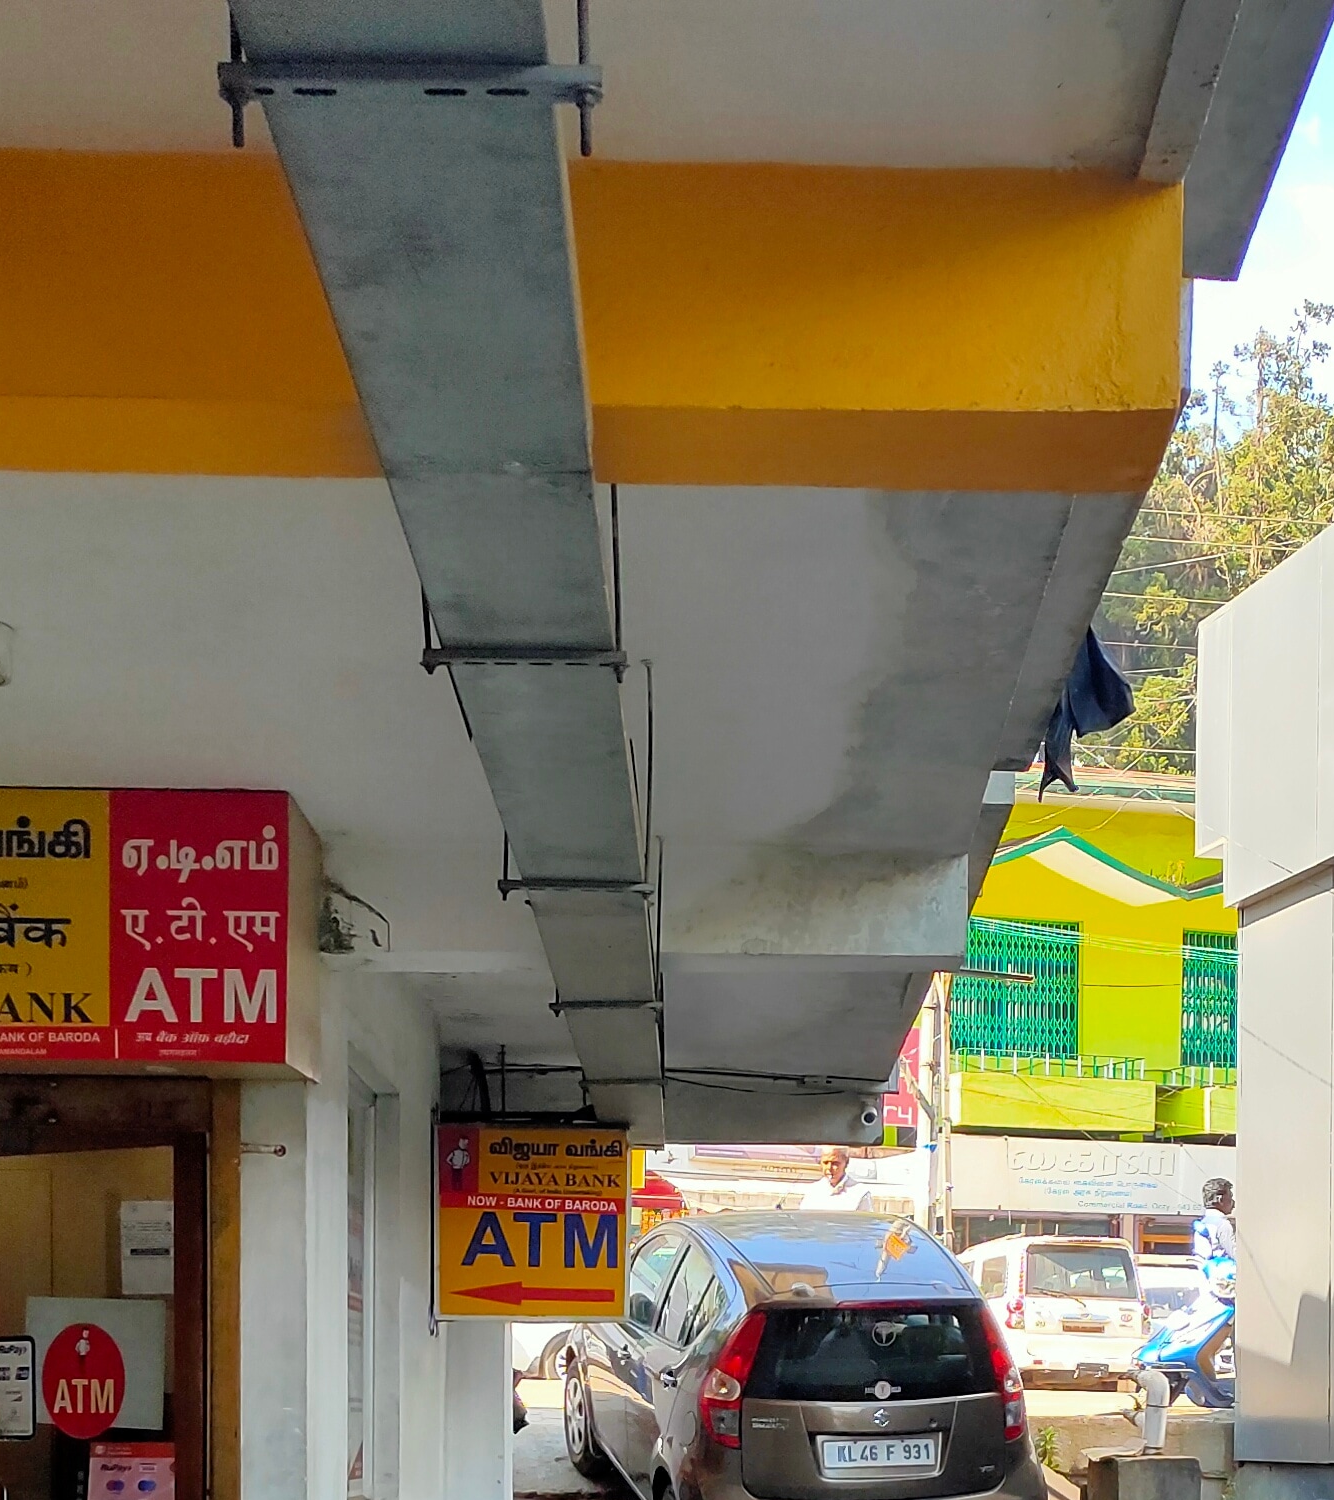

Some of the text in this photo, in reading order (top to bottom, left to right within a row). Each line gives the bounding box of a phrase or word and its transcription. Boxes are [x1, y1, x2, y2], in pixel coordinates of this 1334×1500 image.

[122, 825, 279, 883] ஏ.டி.எம்
[124, 967, 277, 1024] ATM
[28, 1032, 44, 1043] OF
[48, 1032, 100, 1043] BARODA
[489, 1136, 623, 1161] விஜயா வங்கி
[490, 1171, 621, 1188] VIJAYA BANK
[467, 1195, 497, 1207] NOW
[507, 1197, 542, 1209] BANK
[545, 1199, 561, 1209] OF
[565, 1200, 618, 1212] BARODA
[461, 1211, 619, 1269] ATM
[53, 1378, 115, 1414] ATM
[886, 1444, 895, 1462] F
[903, 1443, 931, 1461] 931
